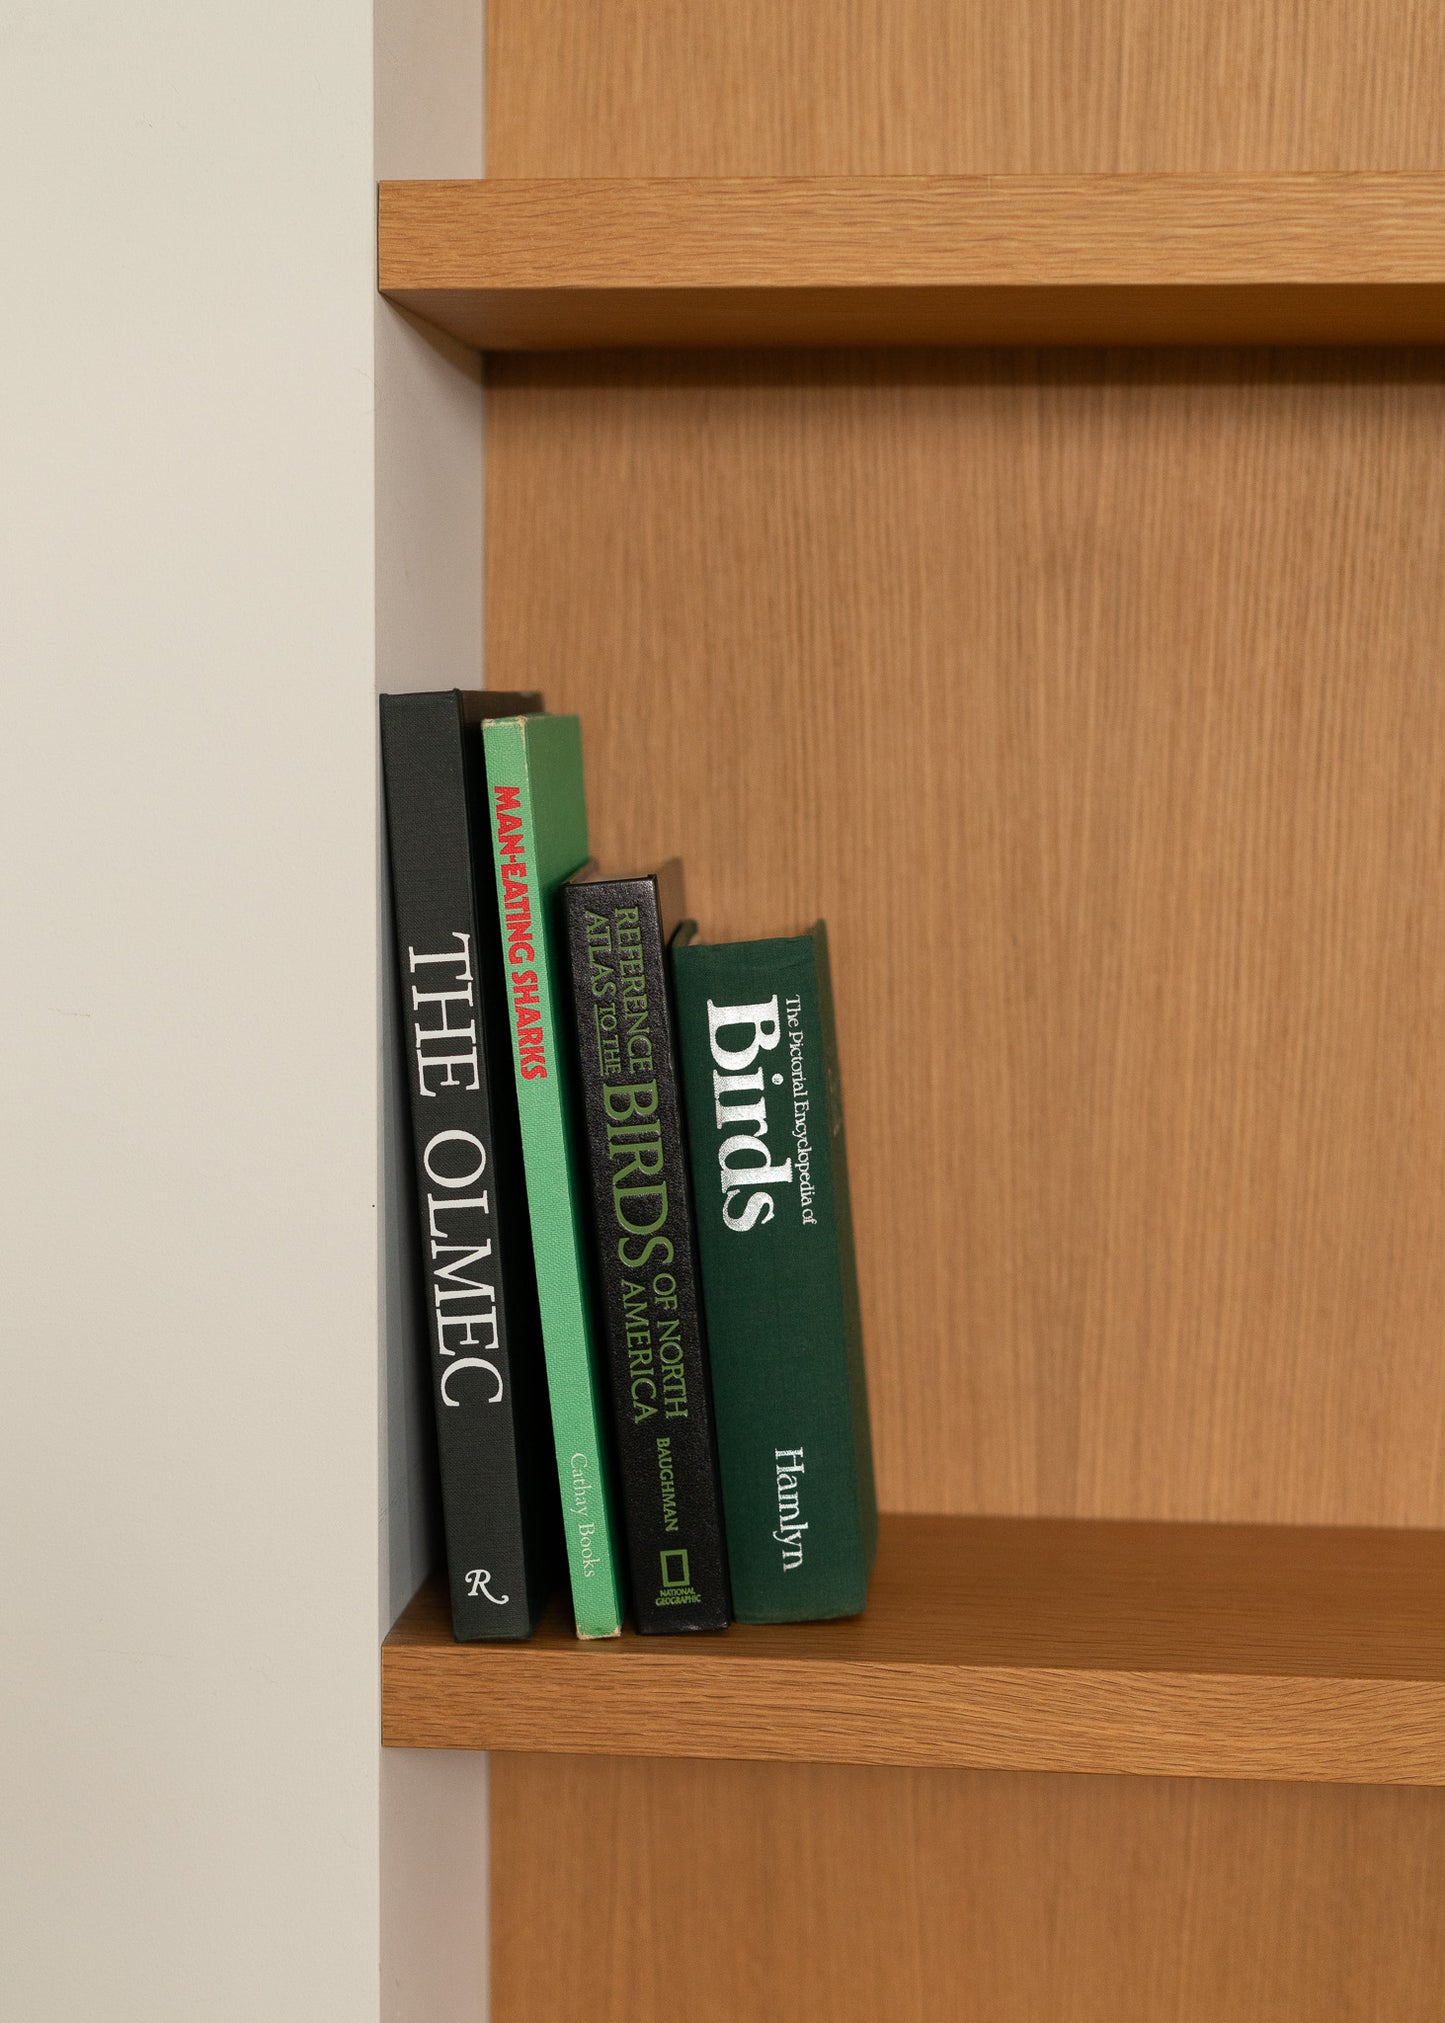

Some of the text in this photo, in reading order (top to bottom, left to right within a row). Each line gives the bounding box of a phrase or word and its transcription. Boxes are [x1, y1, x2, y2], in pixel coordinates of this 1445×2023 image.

[494, 785, 547, 1080] MAN-EATING SHARKS
[585, 910, 621, 1075] ATLAS TO THE
[615, 907, 654, 1074] REFERENCE
[408, 932, 503, 1406] THE OLMEC
[603, 1079, 674, 1269] BIRDS
[707, 994, 793, 1232] Birds
[786, 994, 817, 1225] The Pictorial Encyclopedia of
[621, 1279, 658, 1424] AMERICA
[653, 1273, 688, 1419] OF NORTH
[570, 1452, 600, 1578] Cathay Books
[656, 1437, 678, 1532] BAUGHMAN
[772, 1447, 809, 1572] Hamlyn
[655, 1594, 702, 1606] GEOGRAPHIC
[660, 1587, 696, 1597] NATIONAL
